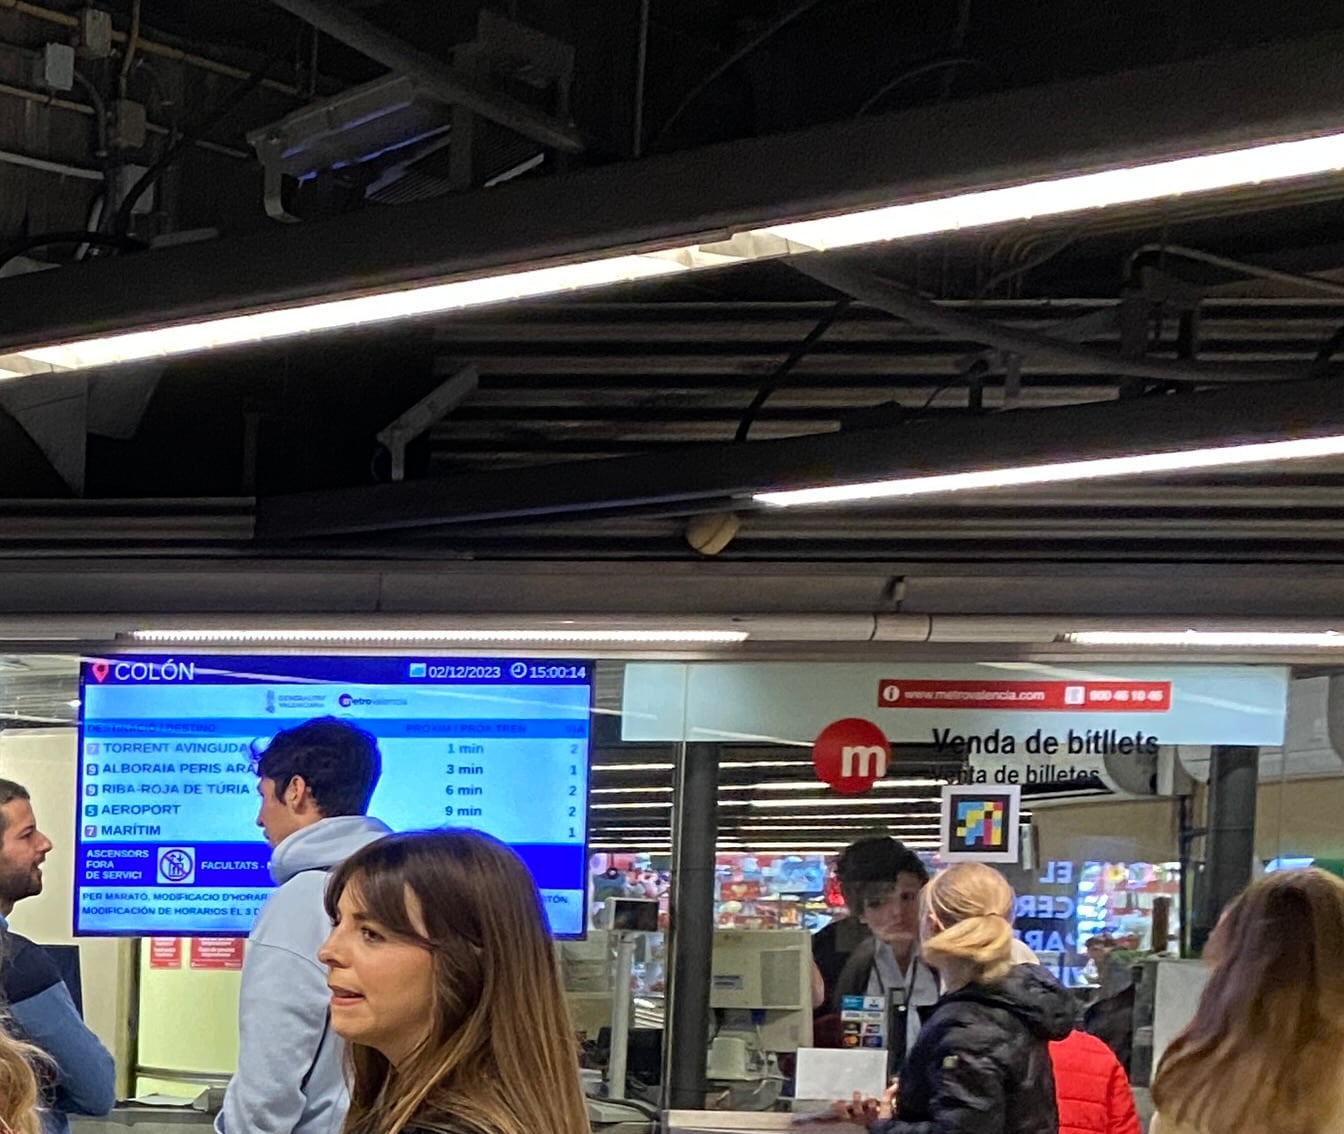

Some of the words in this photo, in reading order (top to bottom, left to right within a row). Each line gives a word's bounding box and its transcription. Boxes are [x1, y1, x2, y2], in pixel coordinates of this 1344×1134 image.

[115, 659, 195, 681] COLÓN
[428, 666, 501, 679] 02/12/2023
[529, 666, 586, 679] 15:00:14
[904, 690, 1045, 701] www.metrovalencia.com
[932, 728, 1014, 755] Venda
[1026, 728, 1058, 755] de
[1068, 728, 1160, 755] bitllets
[104, 743, 170, 753] TORRENT
[175, 743, 250, 753] AVINGUDA
[447, 744, 455, 754] 1
[459, 744, 484, 754] min
[570, 744, 578, 754] 2
[102, 764, 175, 774] ALBORAIA
[180, 764, 222, 774] PERIS
[226, 764, 256, 774] ARA
[446, 764, 454, 774] 3
[459, 764, 483, 774] min
[570, 765, 577, 775] 1
[995, 765, 1019, 784] de
[1026, 765, 1100, 785] billetes
[102, 784, 179, 794] RIBA-ROJA
[184, 784, 202, 794] DE
[208, 781, 250, 794] TÚRIA
[445, 785, 453, 795] 6
[458, 785, 483, 795] min
[569, 785, 577, 796] 2
[101, 805, 181, 815] AEROPORT
[445, 806, 453, 816] 9
[457, 806, 482, 816] min
[569, 806, 577, 817] 2
[101, 824, 161, 836] MARÍTIM
[568, 827, 577, 838] 1
[87, 850, 149, 858] ASCENSORS
[86, 860, 114, 869] FORA
[201, 861, 258, 870] FACULTATS
[86, 871, 100, 880] DE
[102, 871, 142, 880] SERVICI
[83, 893, 102, 901] PER
[82, 905, 155, 915] MODIFICACIÓN
[158, 906, 172, 915] DE
[175, 906, 227, 915] HORARIOS
[231, 906, 242, 915] EL
